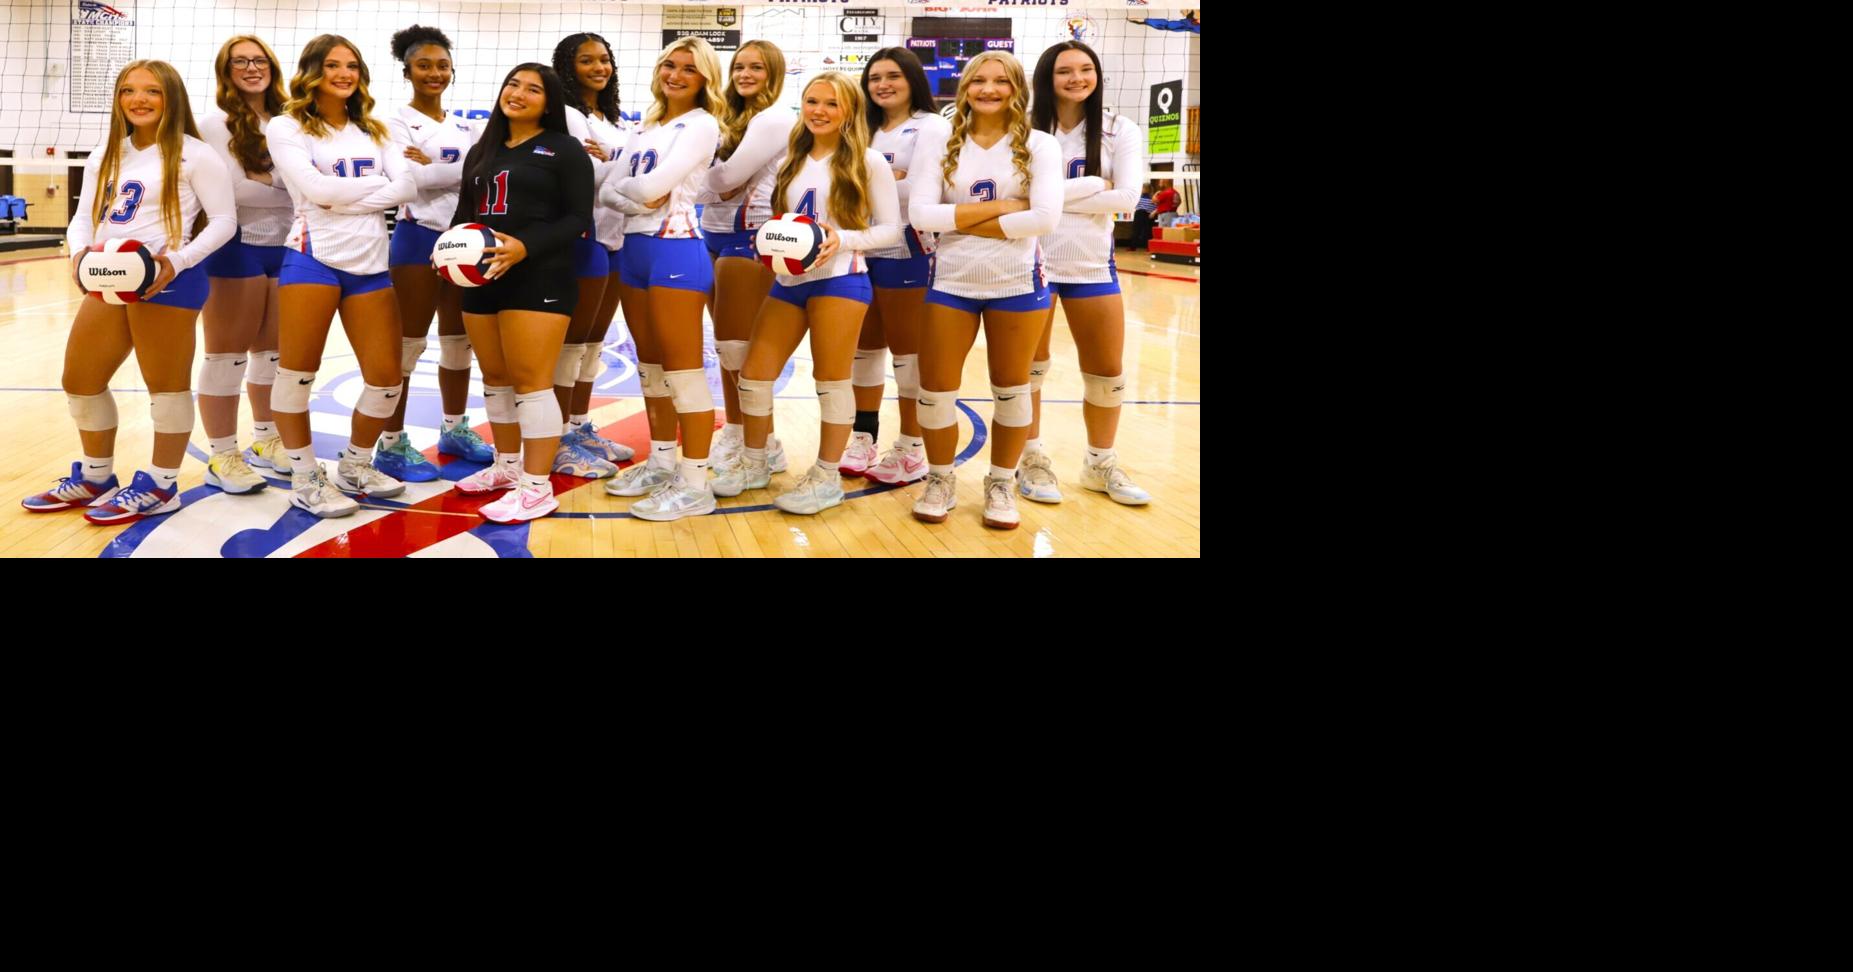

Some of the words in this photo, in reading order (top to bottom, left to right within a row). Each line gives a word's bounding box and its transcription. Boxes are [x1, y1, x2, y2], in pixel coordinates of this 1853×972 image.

[840, 16, 878, 33] CITY
[1157, 87, 1173, 114] Q
[1150, 112, 1180, 124] QUIZNOS
[794, 188, 819, 222] 4
[765, 232, 798, 243] Wilson
[438, 241, 467, 251] Wilson
[88, 267, 127, 276] Wilson
